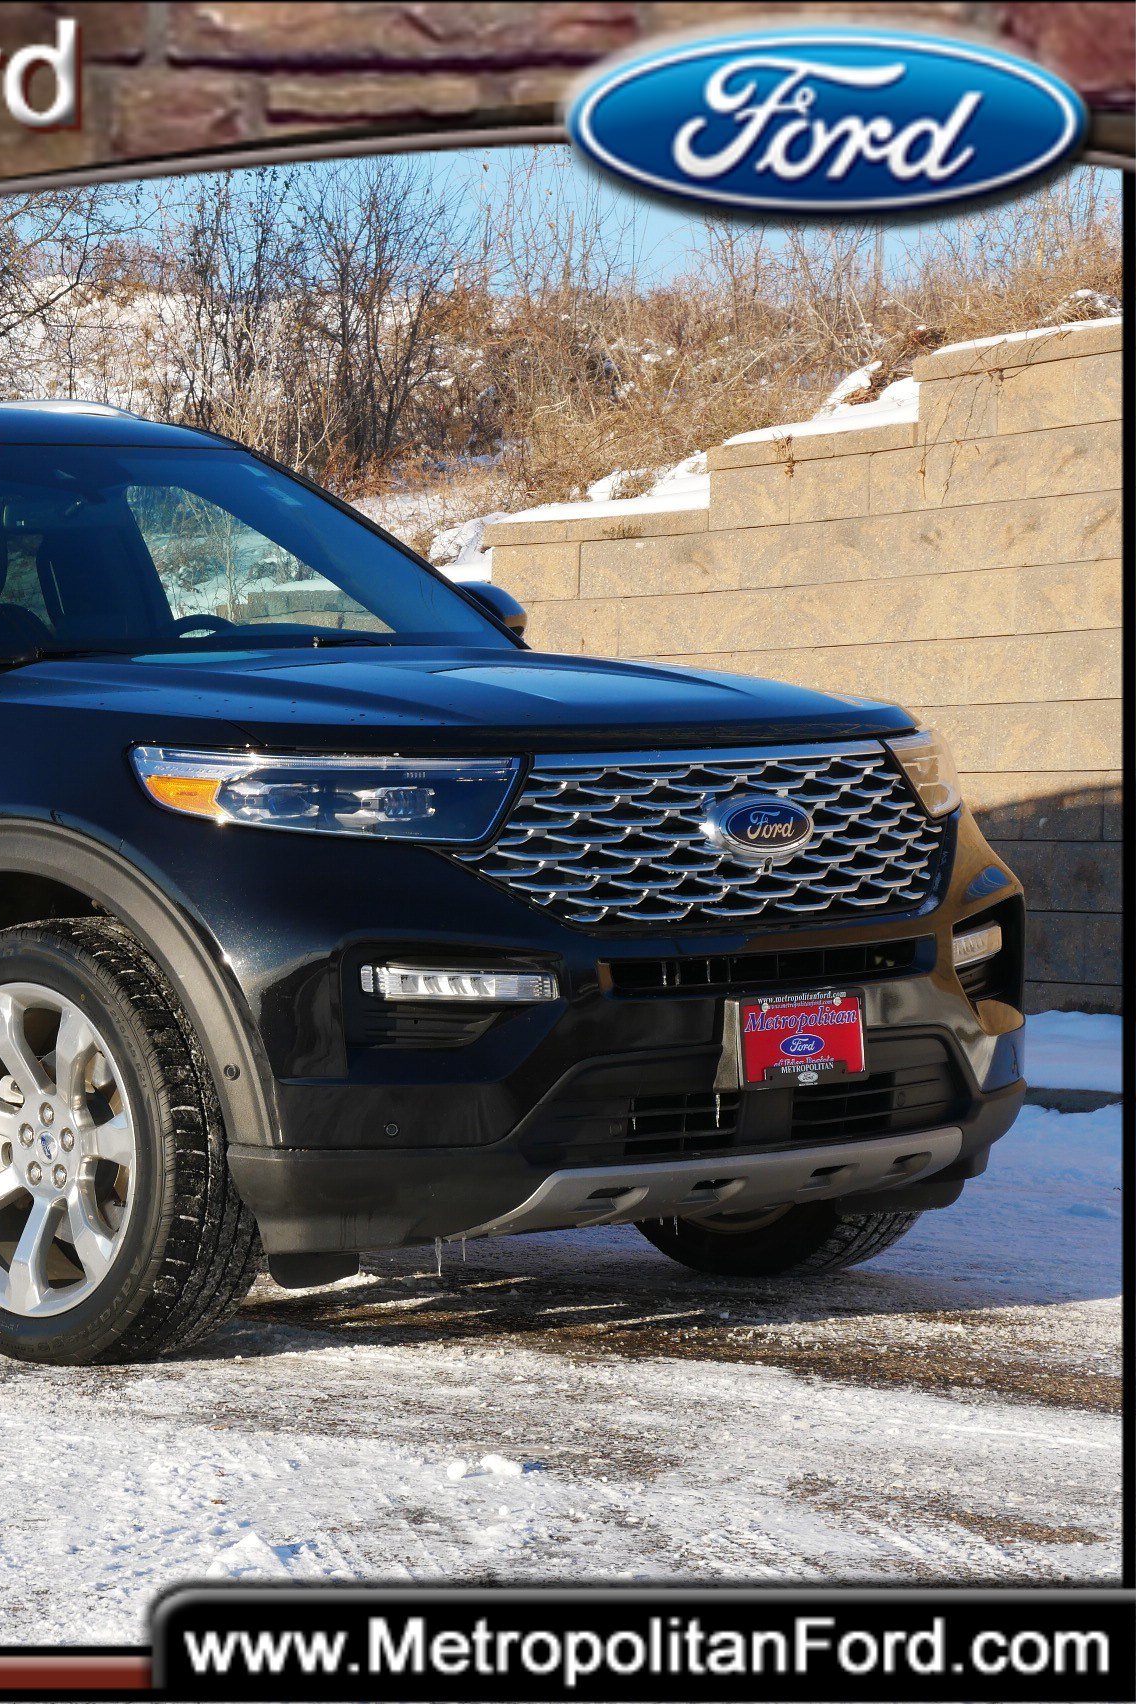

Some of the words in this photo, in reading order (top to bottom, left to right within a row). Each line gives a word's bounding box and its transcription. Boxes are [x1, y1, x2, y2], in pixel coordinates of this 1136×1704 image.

[747, 810, 795, 840] Ford
[744, 1005, 857, 1034] Metropolitan
[790, 1038, 816, 1052] Ford
[781, 1061, 834, 1074] METROPOLITAN
